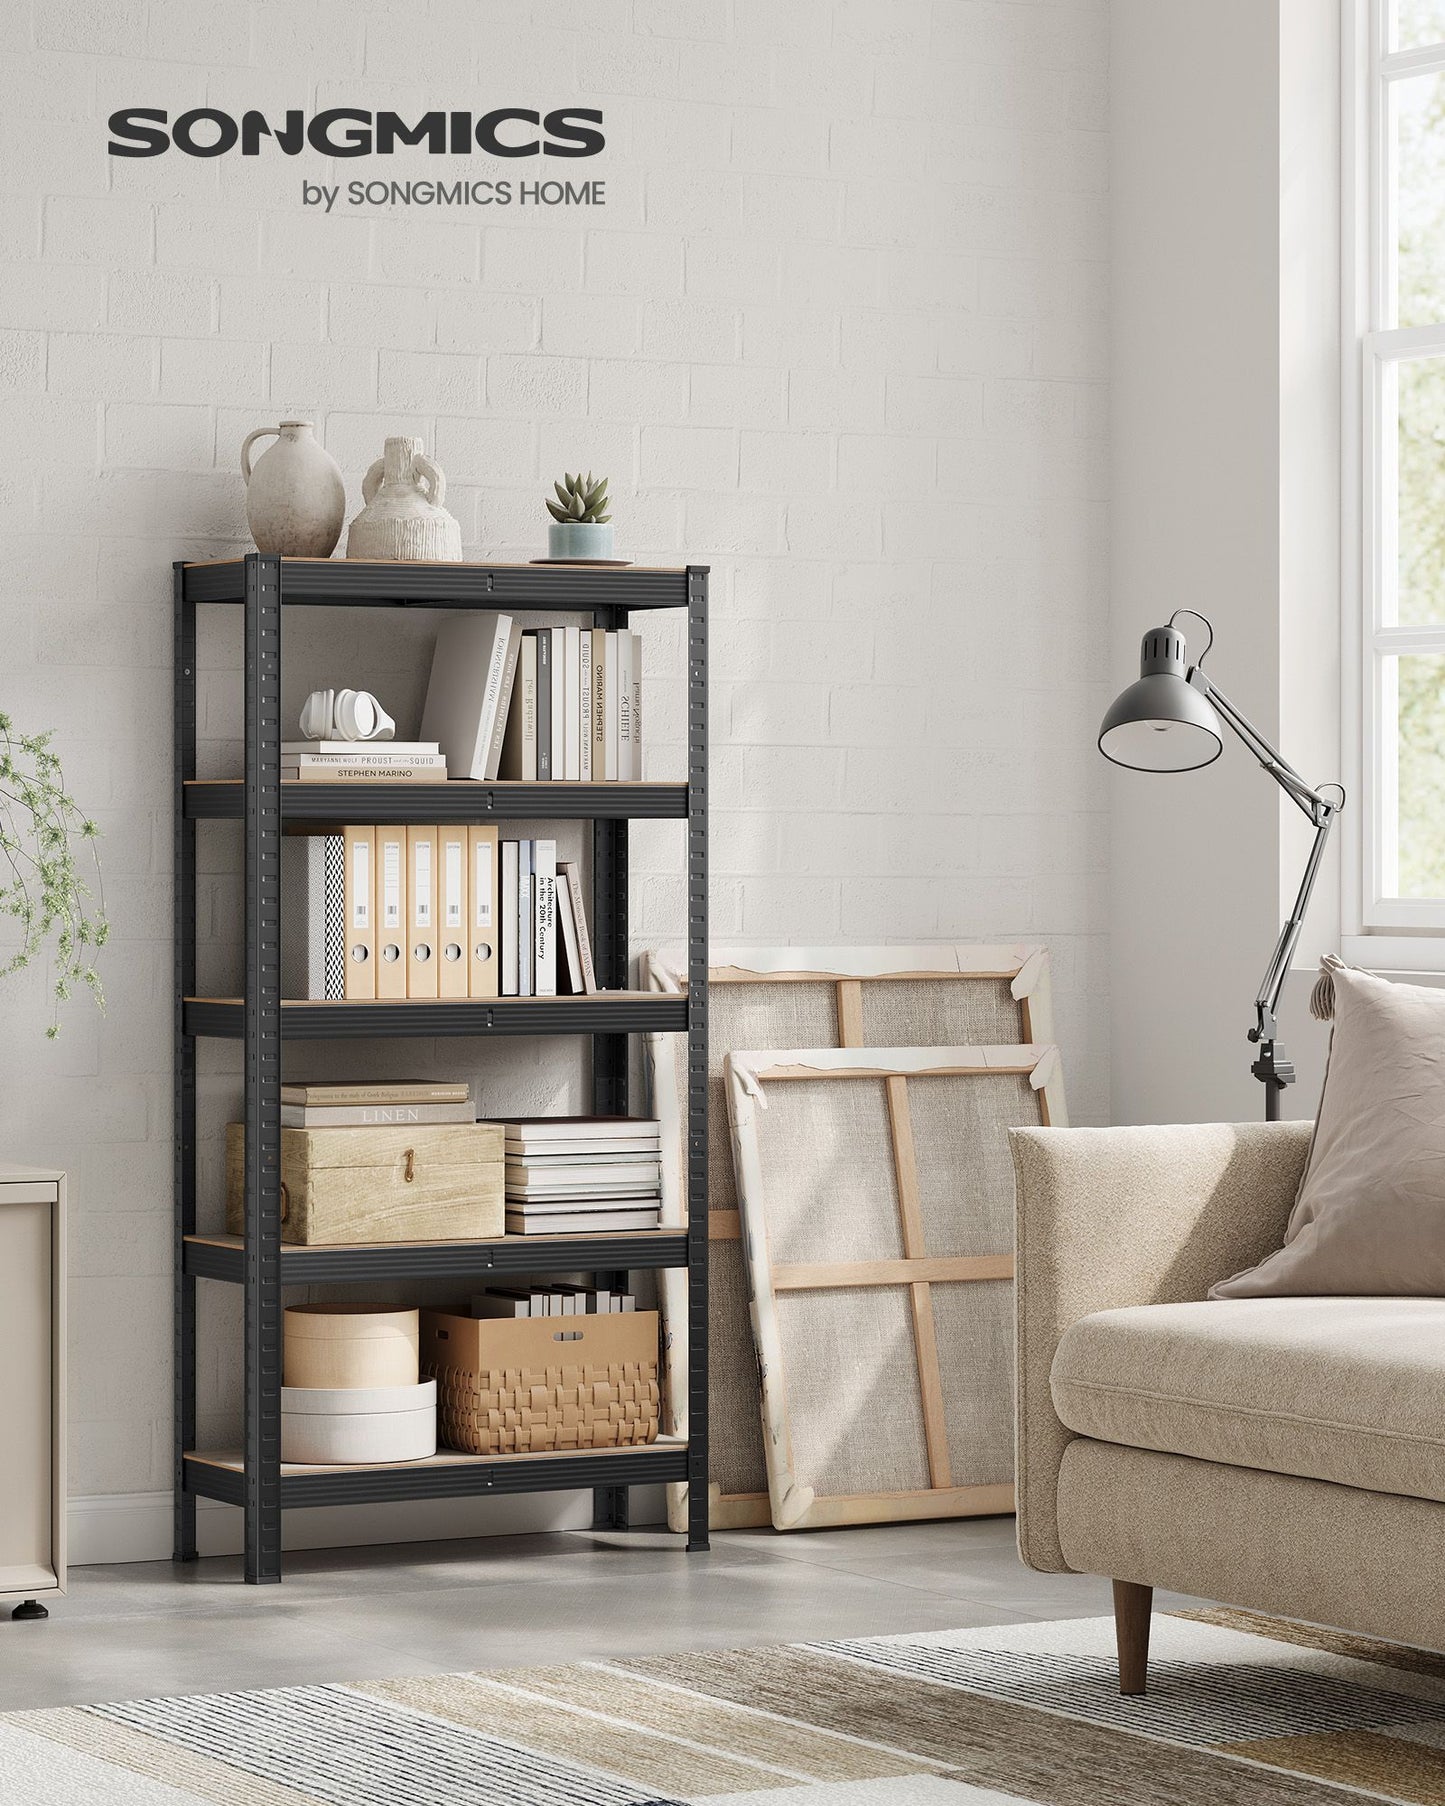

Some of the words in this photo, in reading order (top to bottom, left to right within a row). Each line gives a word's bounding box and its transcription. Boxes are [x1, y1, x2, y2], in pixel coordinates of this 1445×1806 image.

[409, 757, 434, 765] SQUID
[337, 769, 376, 777] STEPHEN
[378, 769, 413, 778] MARINO
[539, 877, 546, 885] in
[538, 926, 546, 960] Century
[363, 1108, 418, 1121] LINEN
